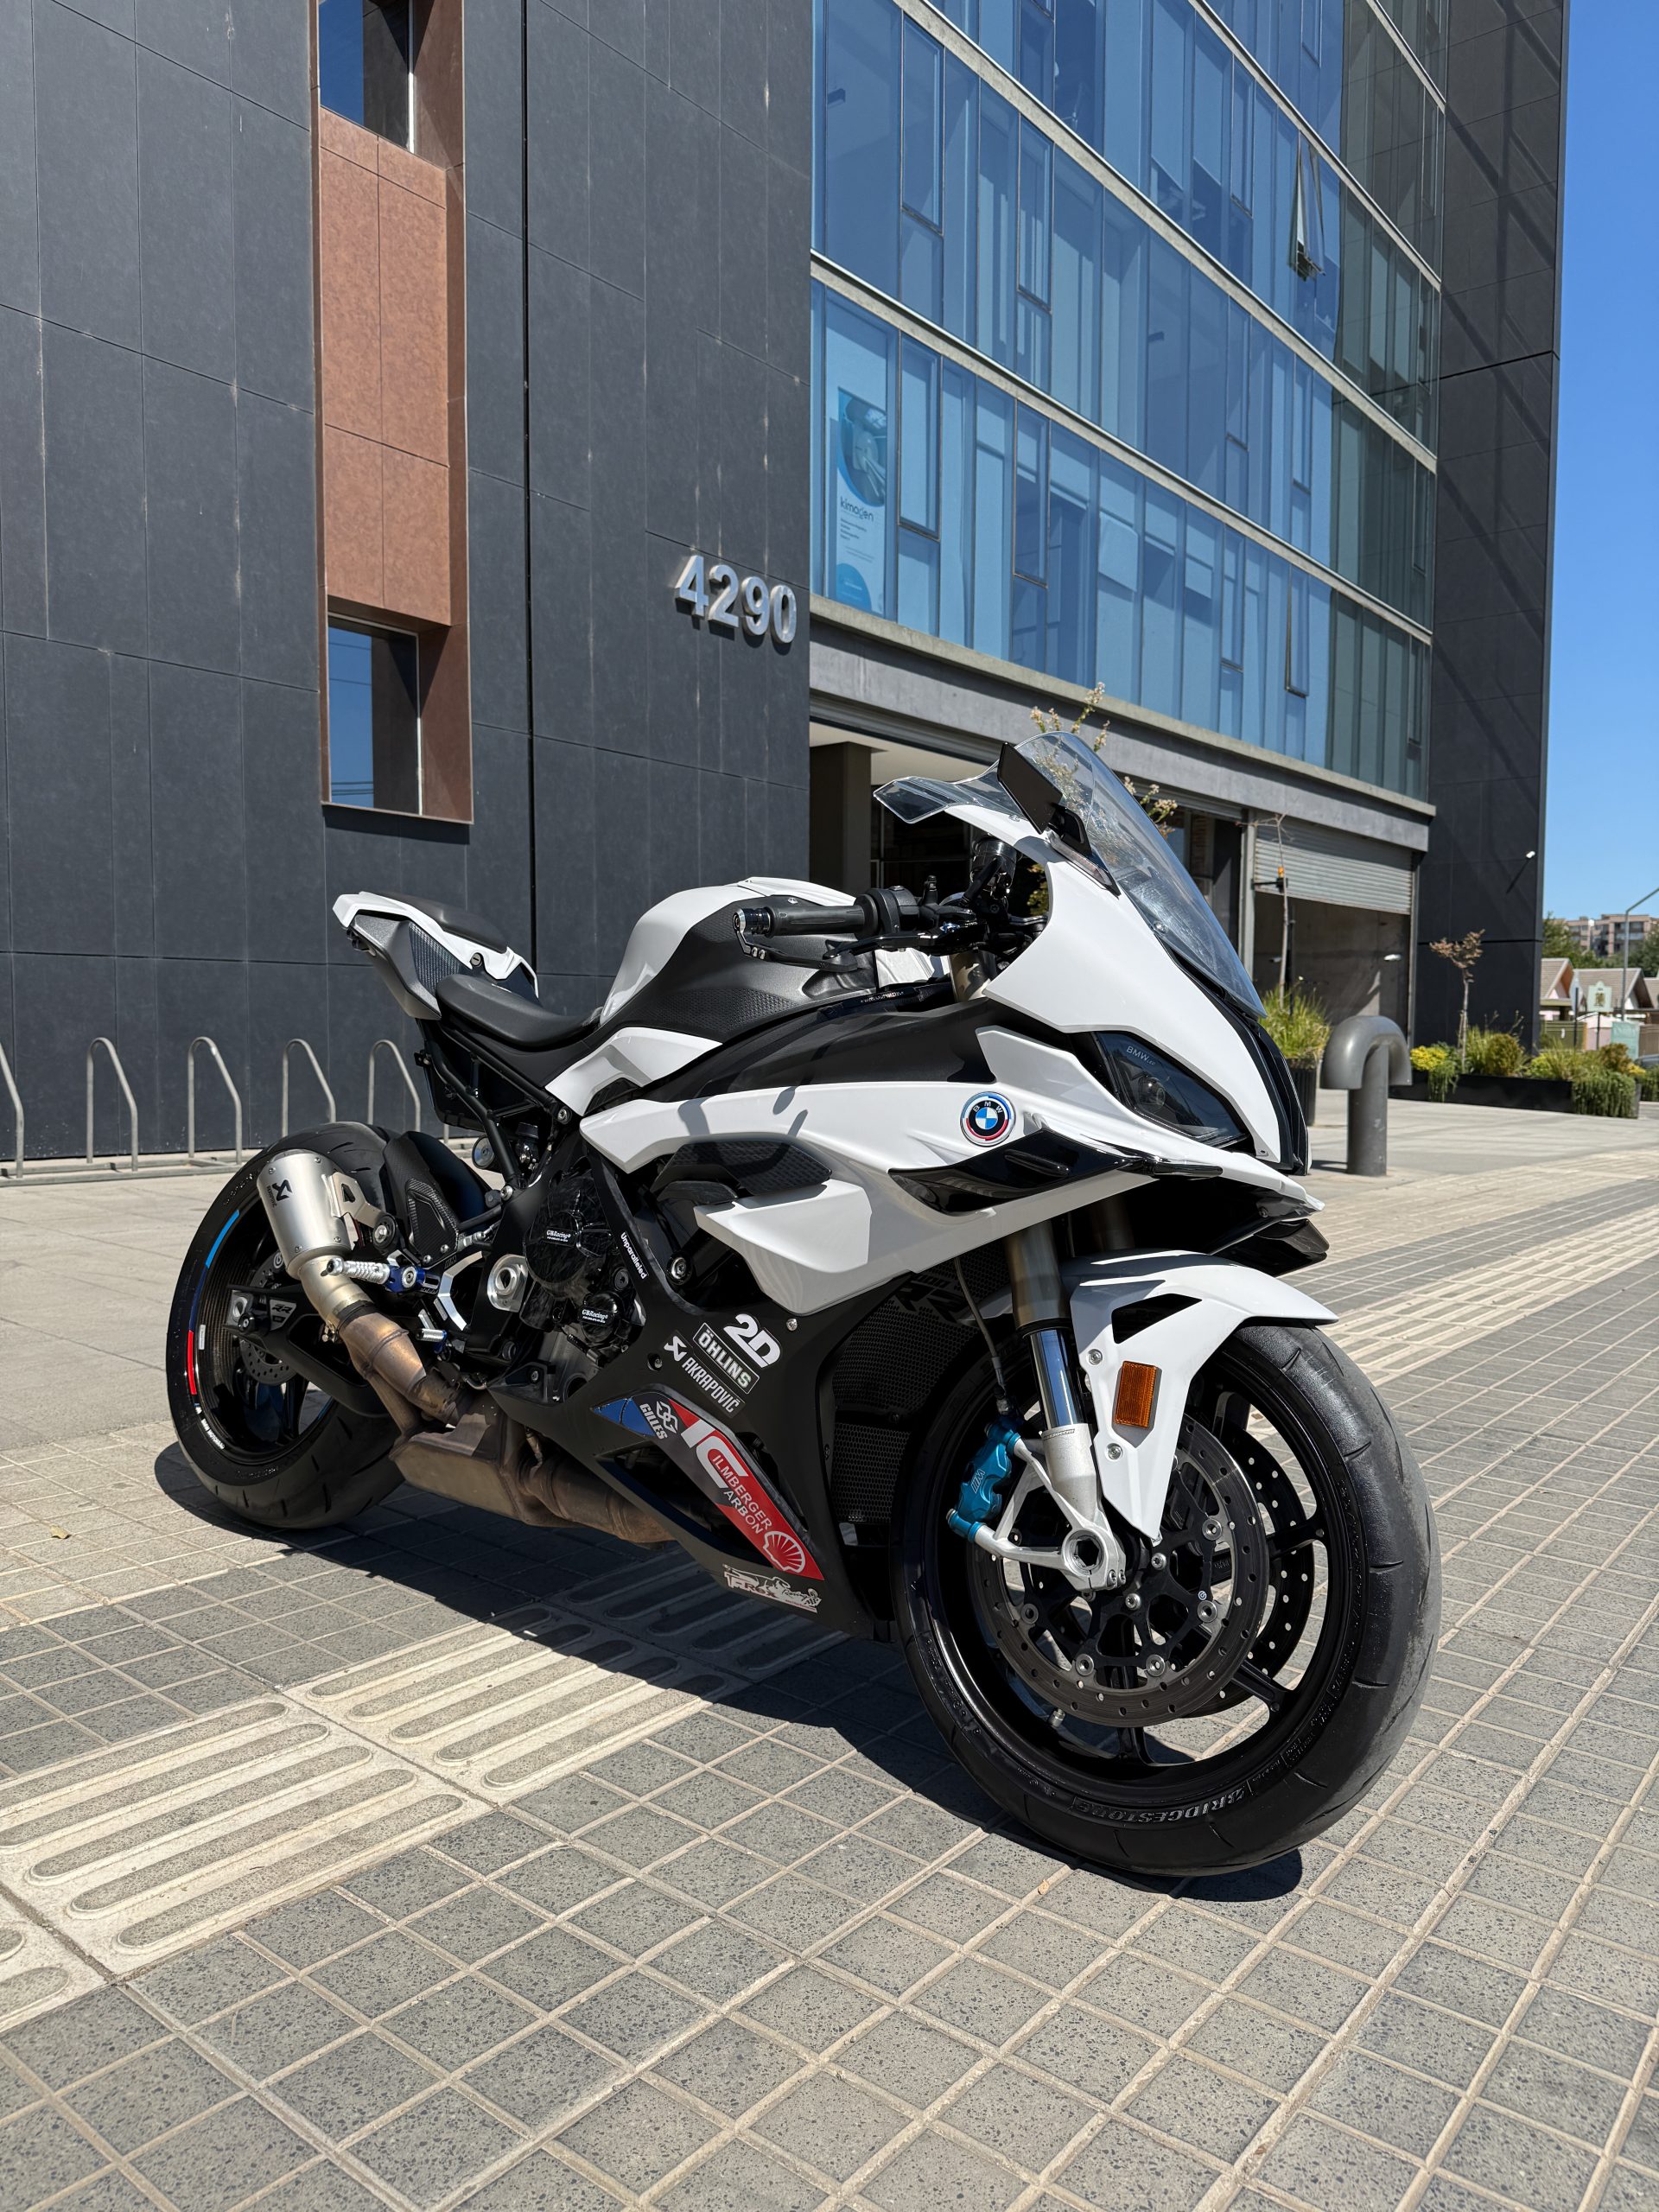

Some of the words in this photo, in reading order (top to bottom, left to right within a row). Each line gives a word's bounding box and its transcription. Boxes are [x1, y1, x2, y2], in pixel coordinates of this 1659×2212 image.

[675, 555, 797, 644] 4290
[1126, 1046, 1149, 1062] BMW
[972, 1101, 1003, 1114] BMW
[620, 1231, 647, 1280] Unparalleled
[697, 1328, 752, 1389] ÖHLINS
[723, 1313, 781, 1369] 2D
[639, 1403, 668, 1440] GILLES
[712, 1454, 772, 1530] ILMBERGER
